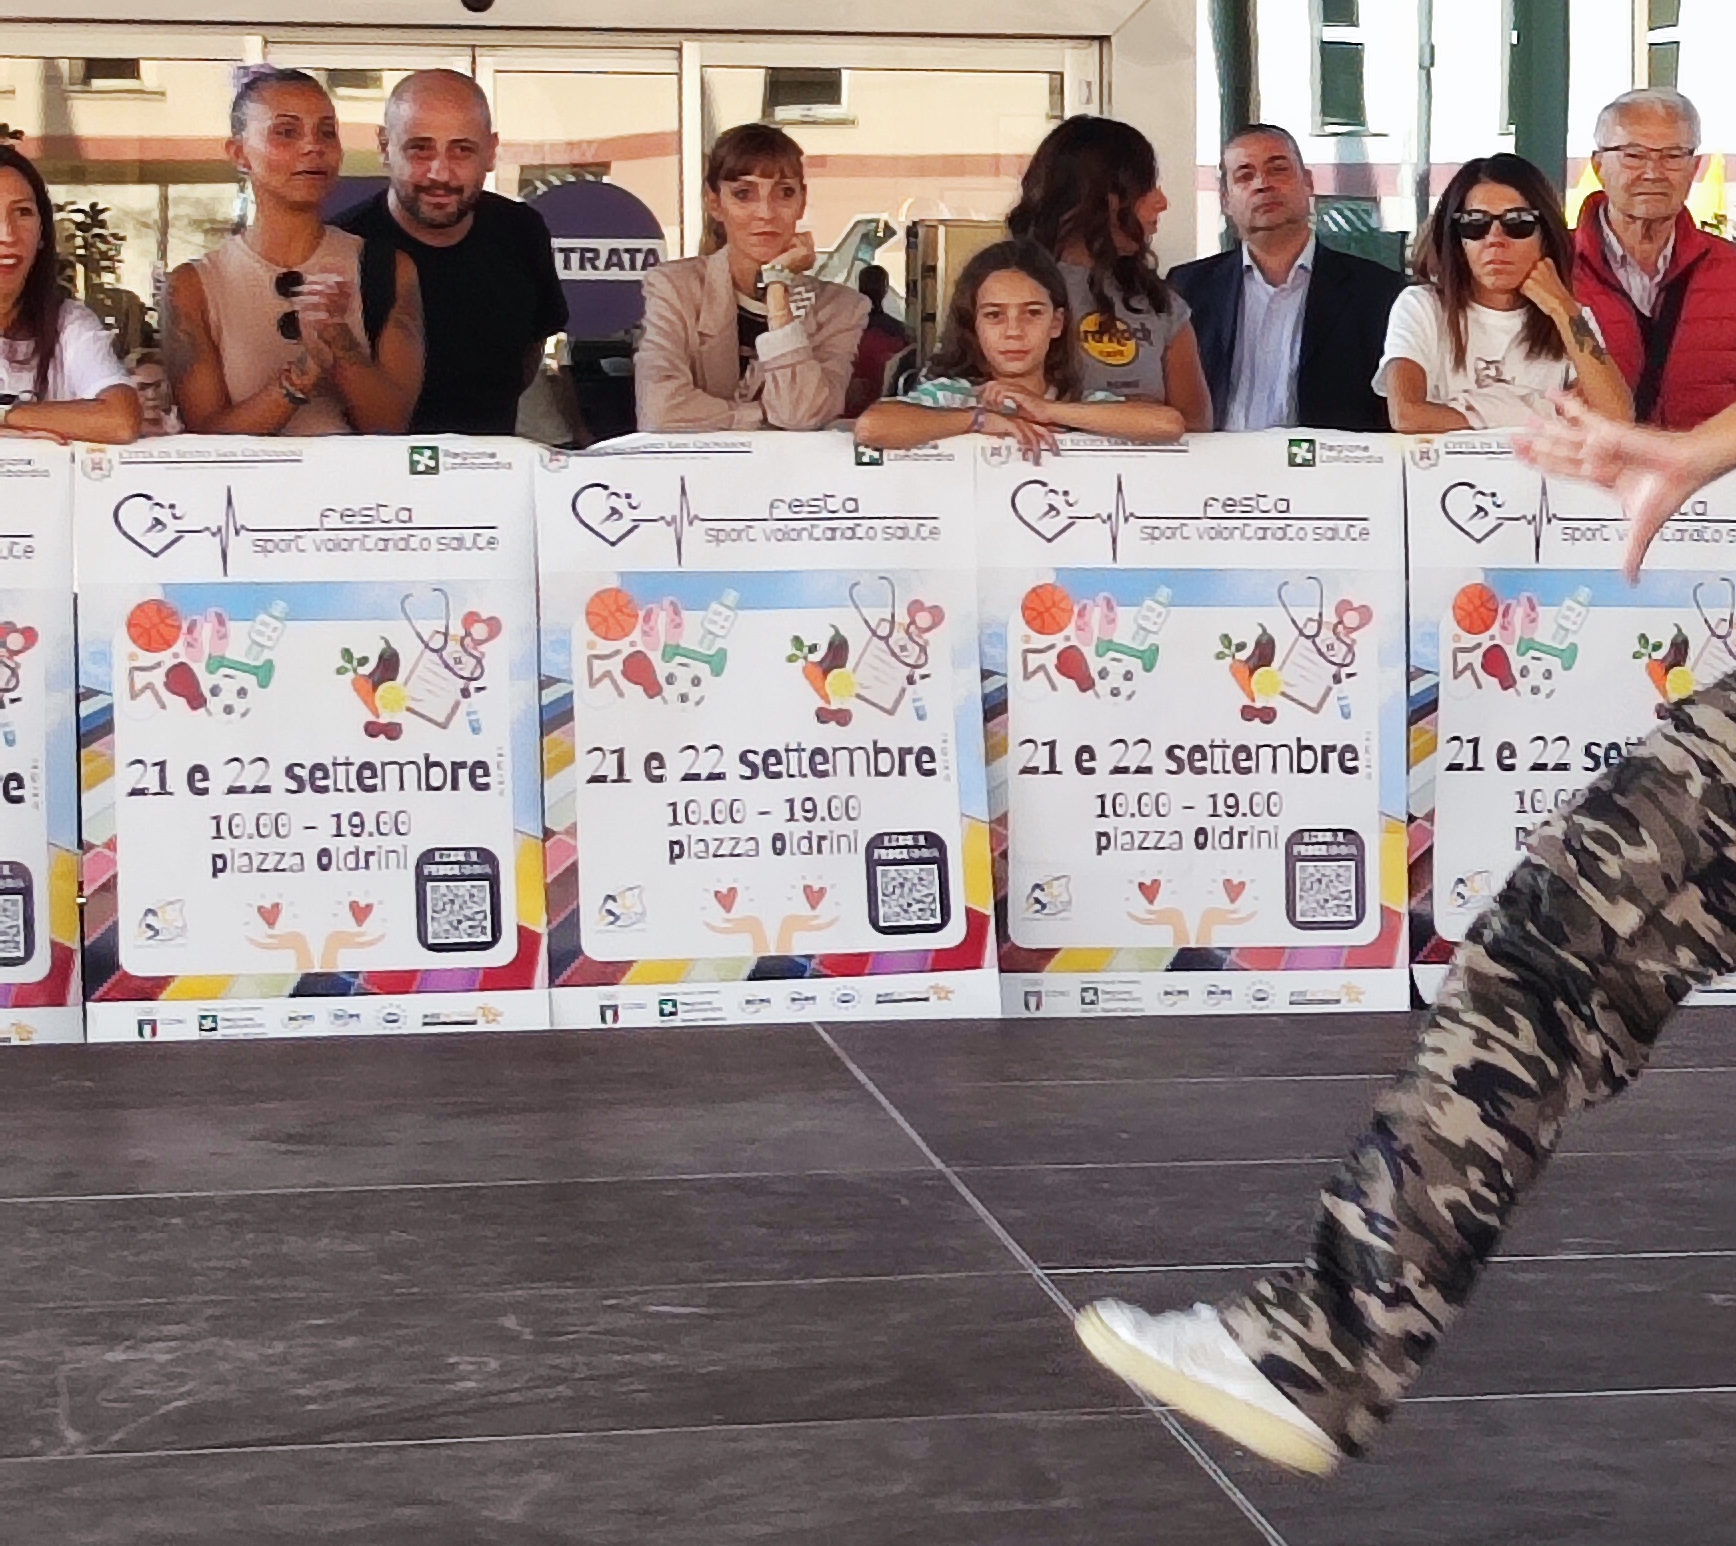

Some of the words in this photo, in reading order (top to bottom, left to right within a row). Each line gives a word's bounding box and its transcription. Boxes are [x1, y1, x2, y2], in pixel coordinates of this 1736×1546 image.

[320, 503, 413, 530] festa
[769, 493, 859, 519] festa
[1203, 493, 1291, 519] festa
[251, 535, 306, 557] sport
[705, 525, 757, 546] sport
[1139, 524, 1190, 545] sport
[1561, 524, 1610, 545] sport
[585, 746, 632, 784] 21
[644, 751, 666, 783] e
[679, 744, 726, 783] 22
[738, 740, 937, 781] settembre
[1018, 738, 1063, 775] 21
[1075, 743, 1096, 774] e
[1109, 738, 1152, 775] 22
[1165, 737, 1360, 775] settembre
[1444, 736, 1485, 772] 21
[1496, 740, 1517, 772] e
[1528, 735, 1571, 772] 22
[126, 758, 174, 797] 21
[187, 763, 210, 796] e
[222, 757, 272, 794] 22
[285, 754, 491, 794] settembre
[667, 798, 746, 827] 10.00
[784, 795, 861, 823] 19.00
[1095, 792, 1171, 818] 10.00
[1206, 792, 1283, 818] 19.00
[211, 812, 292, 840] 10.00
[330, 810, 411, 838] 19.00
[1095, 826, 1183, 855] piazza
[1194, 825, 1279, 851] Oldrini
[211, 847, 305, 878] piazza
[316, 845, 408, 872] Oldrini
[668, 833, 760, 864] piazza
[771, 829, 859, 857] Oldrini
